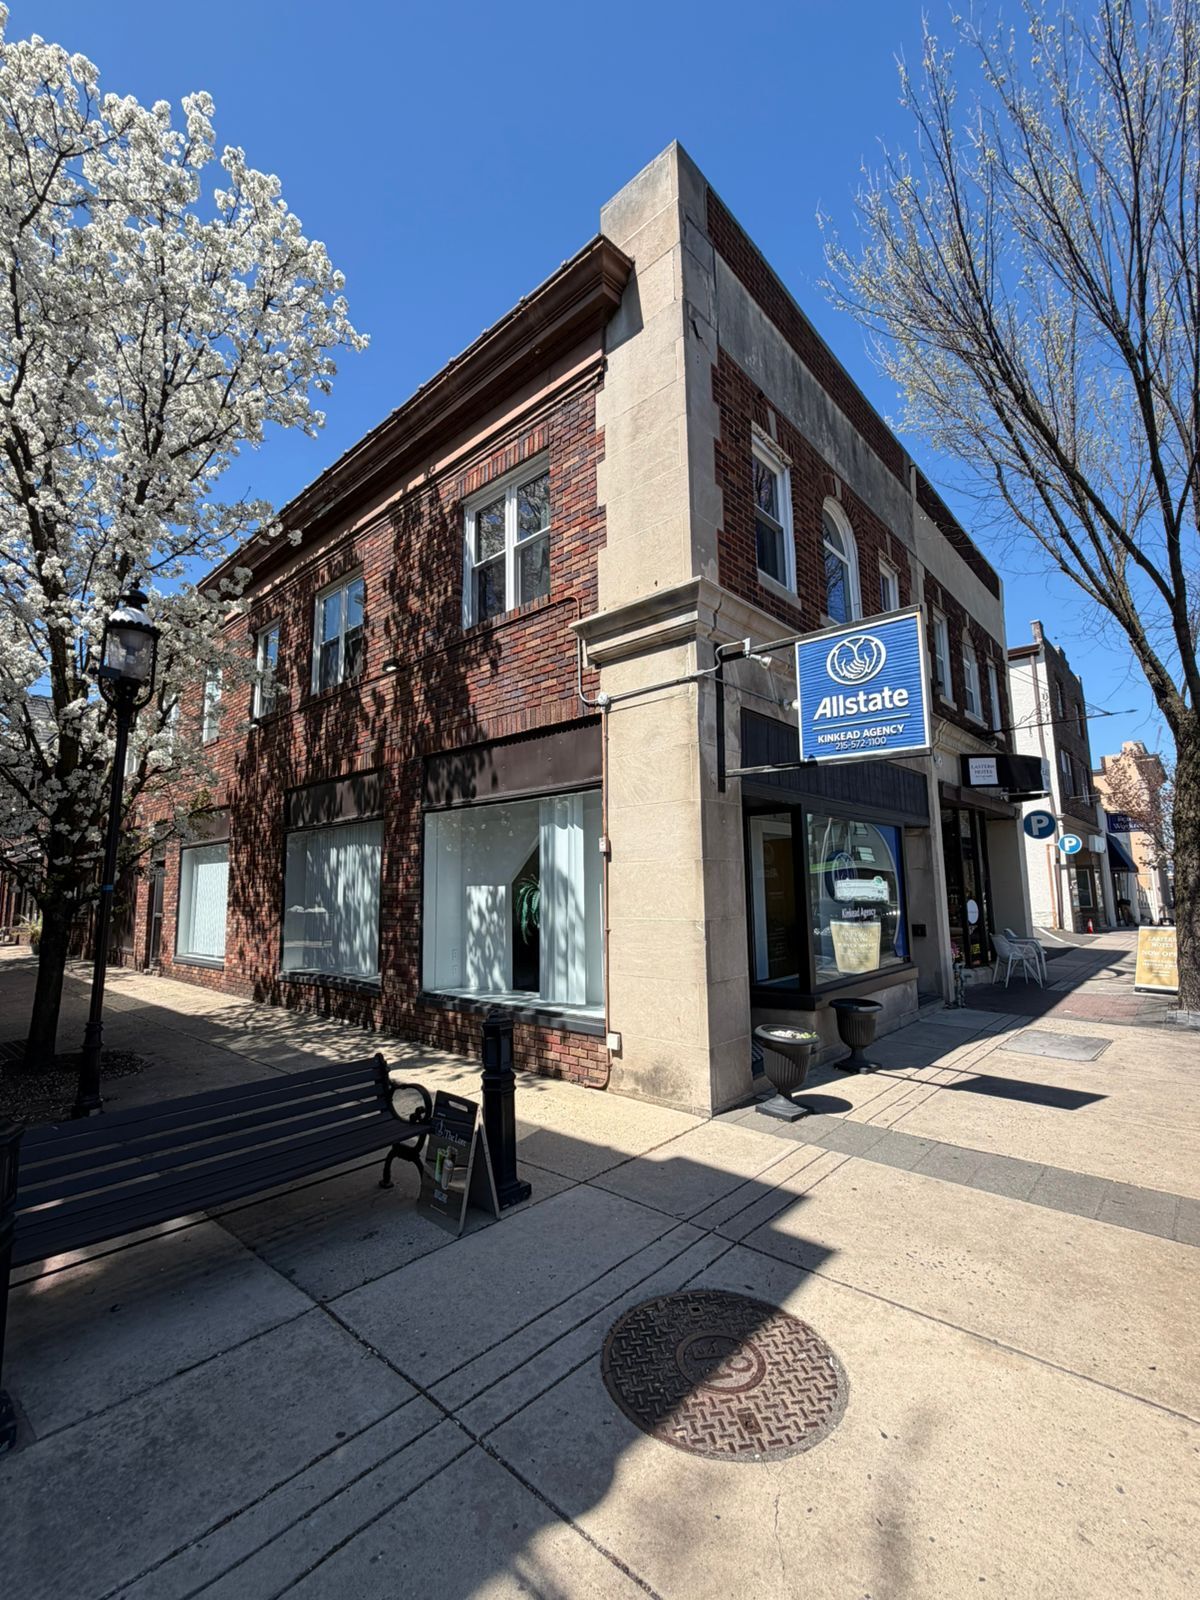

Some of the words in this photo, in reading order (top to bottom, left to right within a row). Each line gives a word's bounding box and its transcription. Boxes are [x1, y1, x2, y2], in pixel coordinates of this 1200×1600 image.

[813, 686, 909, 720] Allstate
[817, 730, 861, 744] KINKEAD
[862, 723, 905, 738] AGENCY
[835, 736, 887, 750] 215-572-1100
[1031, 815, 1050, 836] P
[1064, 837, 1077, 851] P
[861, 907, 876, 919] Agency
